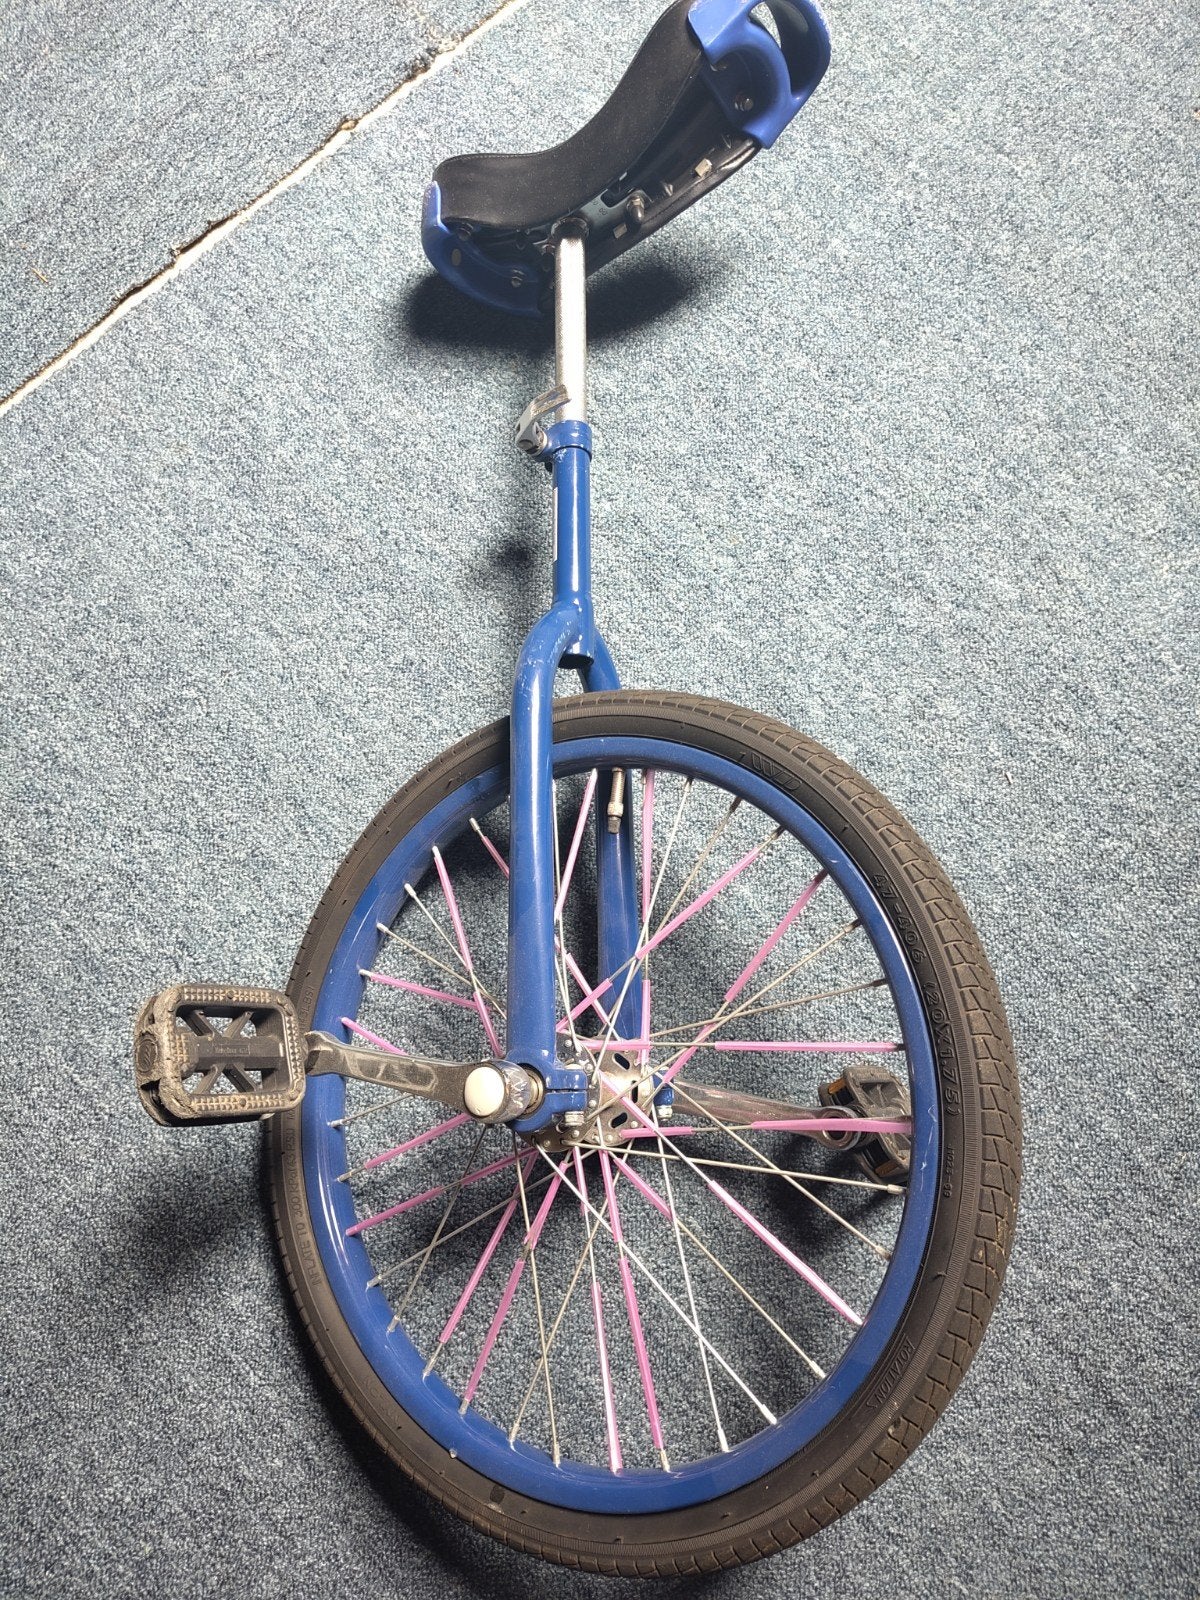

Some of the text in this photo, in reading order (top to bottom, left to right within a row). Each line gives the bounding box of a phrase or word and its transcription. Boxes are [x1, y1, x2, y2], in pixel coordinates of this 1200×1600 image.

[874, 874, 926, 963] 47-406
[289, 1195, 302, 1217] 300
[295, 1222, 307, 1237] TO
